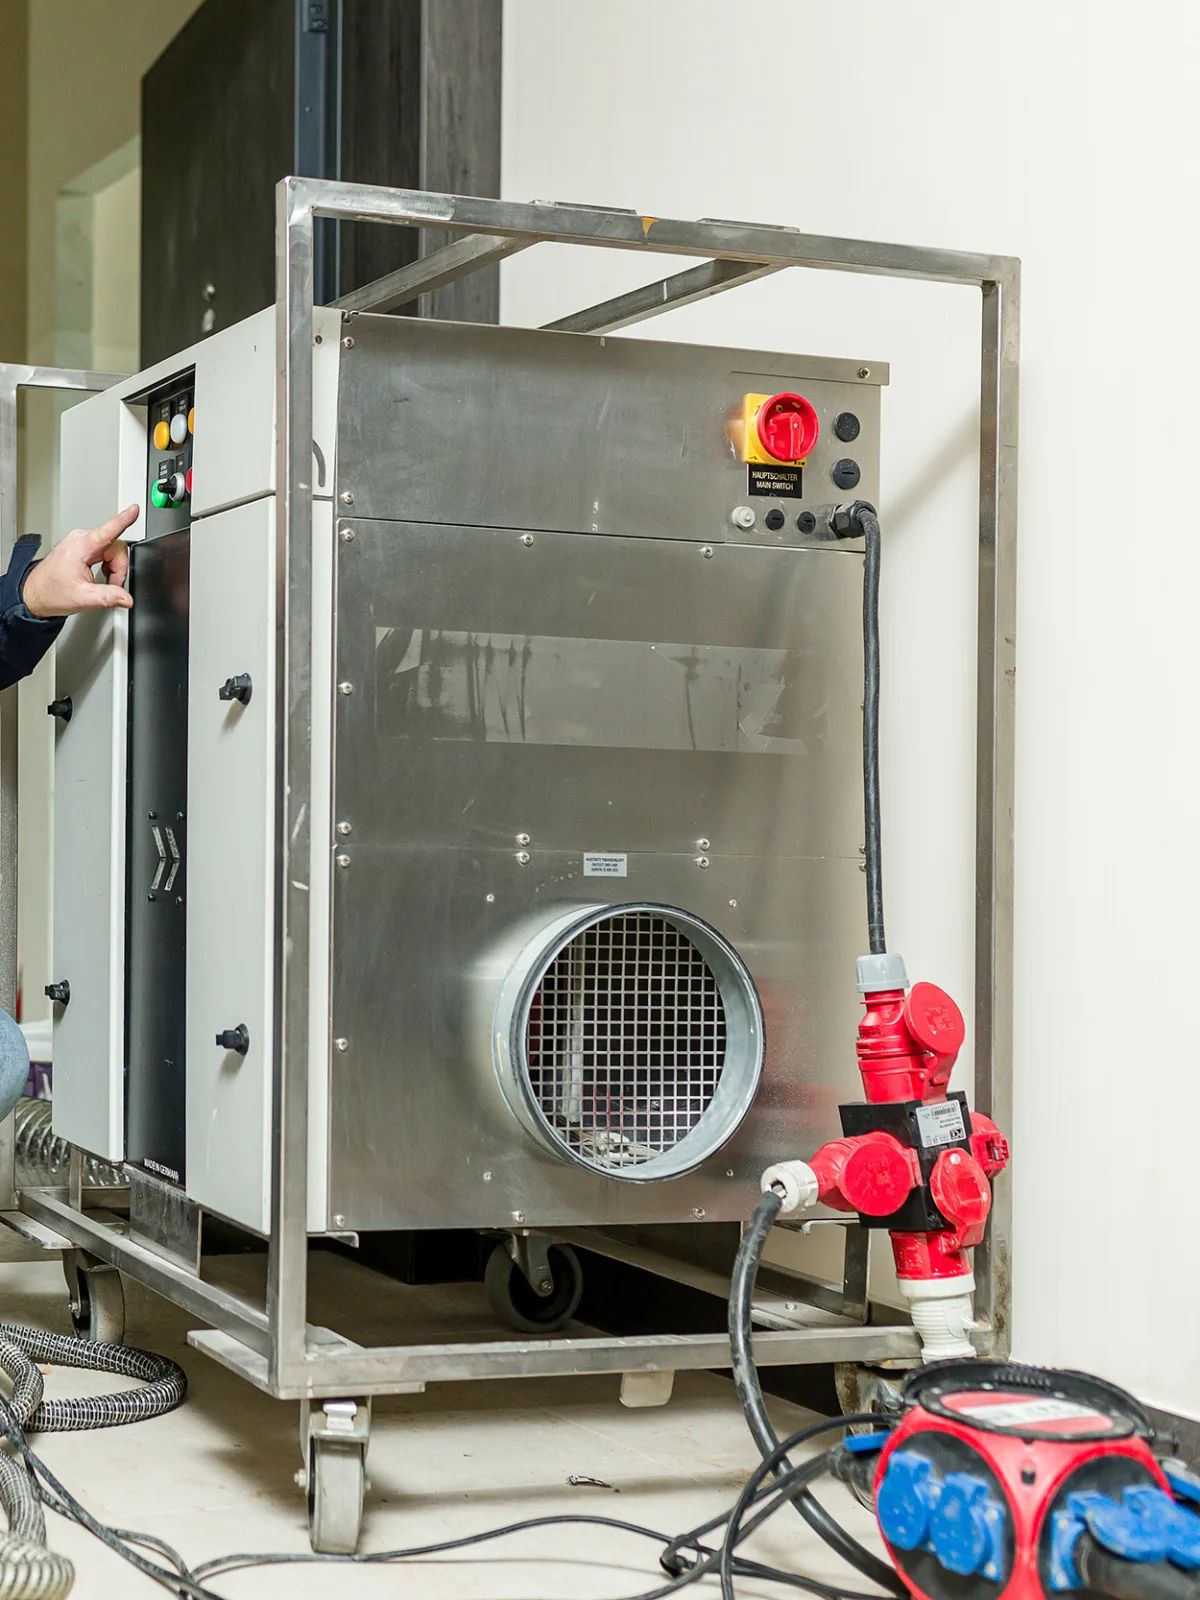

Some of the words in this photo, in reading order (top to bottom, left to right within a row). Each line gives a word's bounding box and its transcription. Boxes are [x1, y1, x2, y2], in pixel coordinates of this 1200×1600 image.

[752, 471, 798, 481] HAUPTSCHALTER
[756, 481, 771, 489] MAIN
[772, 482, 793, 491] SWITCH
